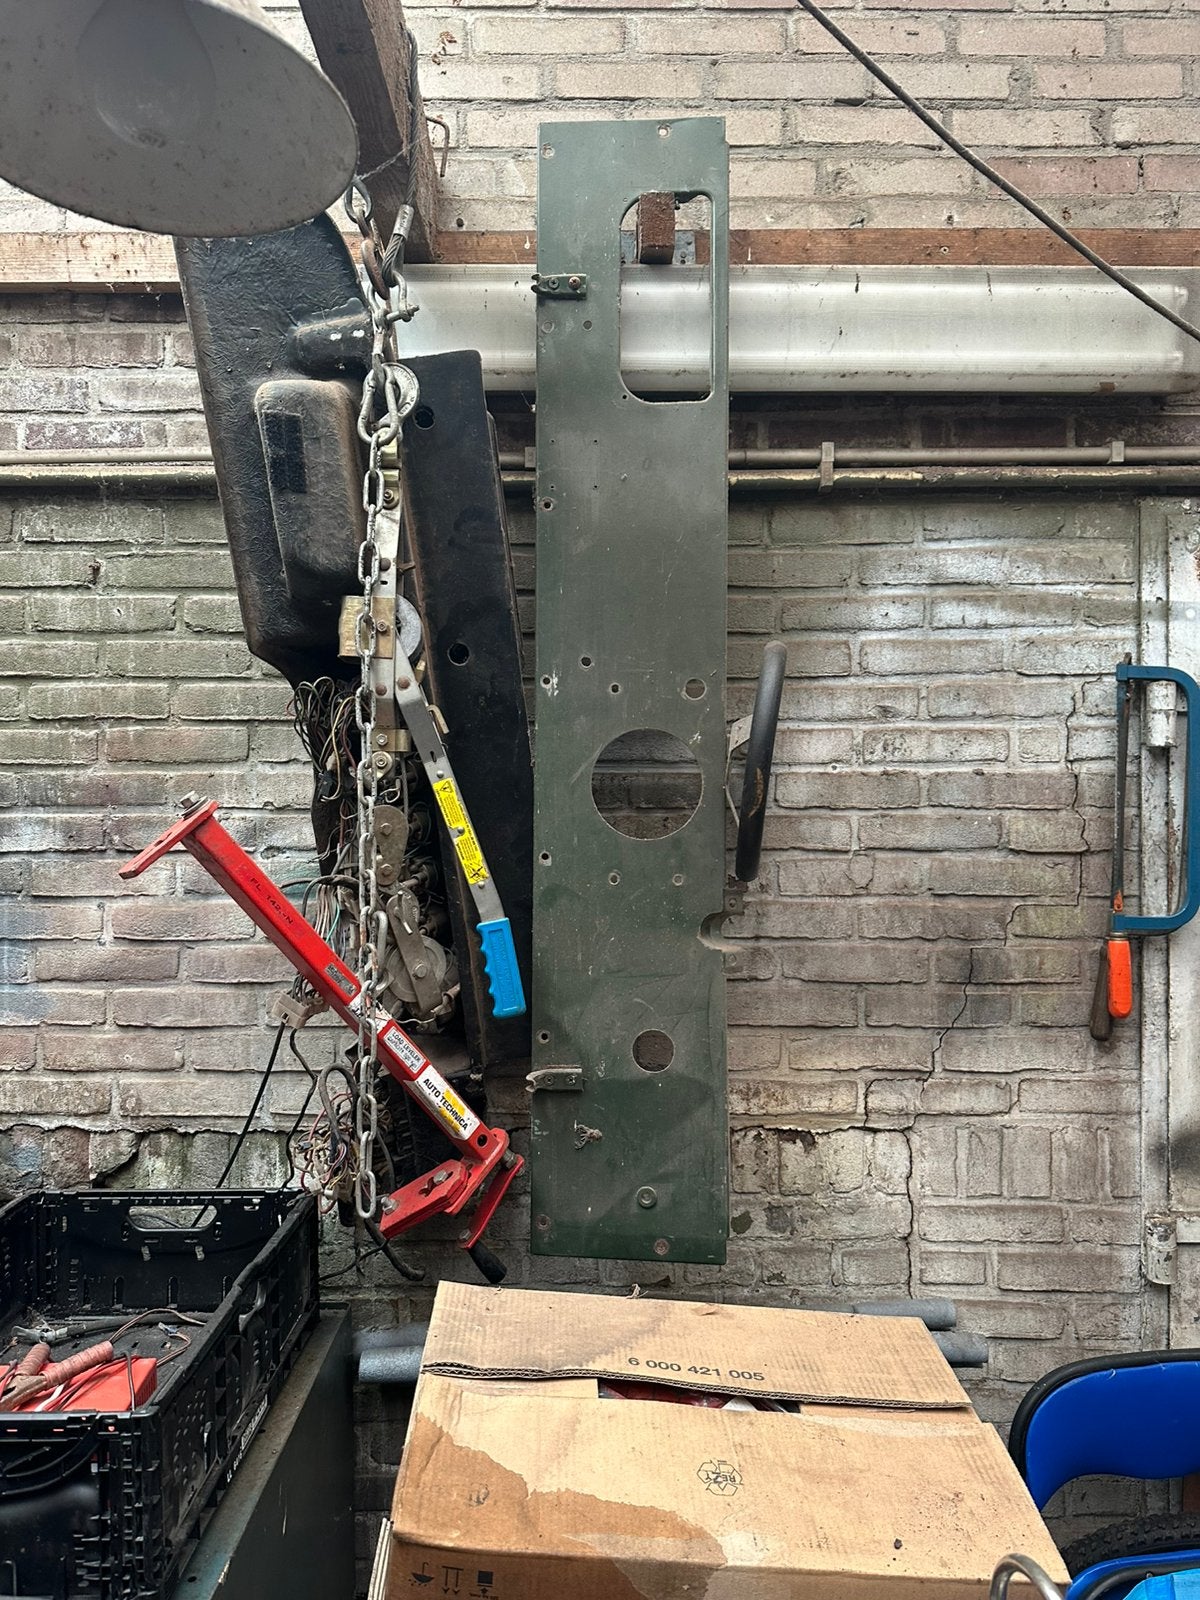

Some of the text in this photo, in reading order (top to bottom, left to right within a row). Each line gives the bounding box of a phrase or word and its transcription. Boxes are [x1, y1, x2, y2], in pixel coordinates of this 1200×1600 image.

[392, 1032, 405, 1045] LOAD
[423, 1078, 442, 1098] AUTO
[439, 1096, 469, 1131] TECHNICA
[628, 1357, 765, 1381] 6 000 421 005
[705, 1471, 737, 1484] REZY
